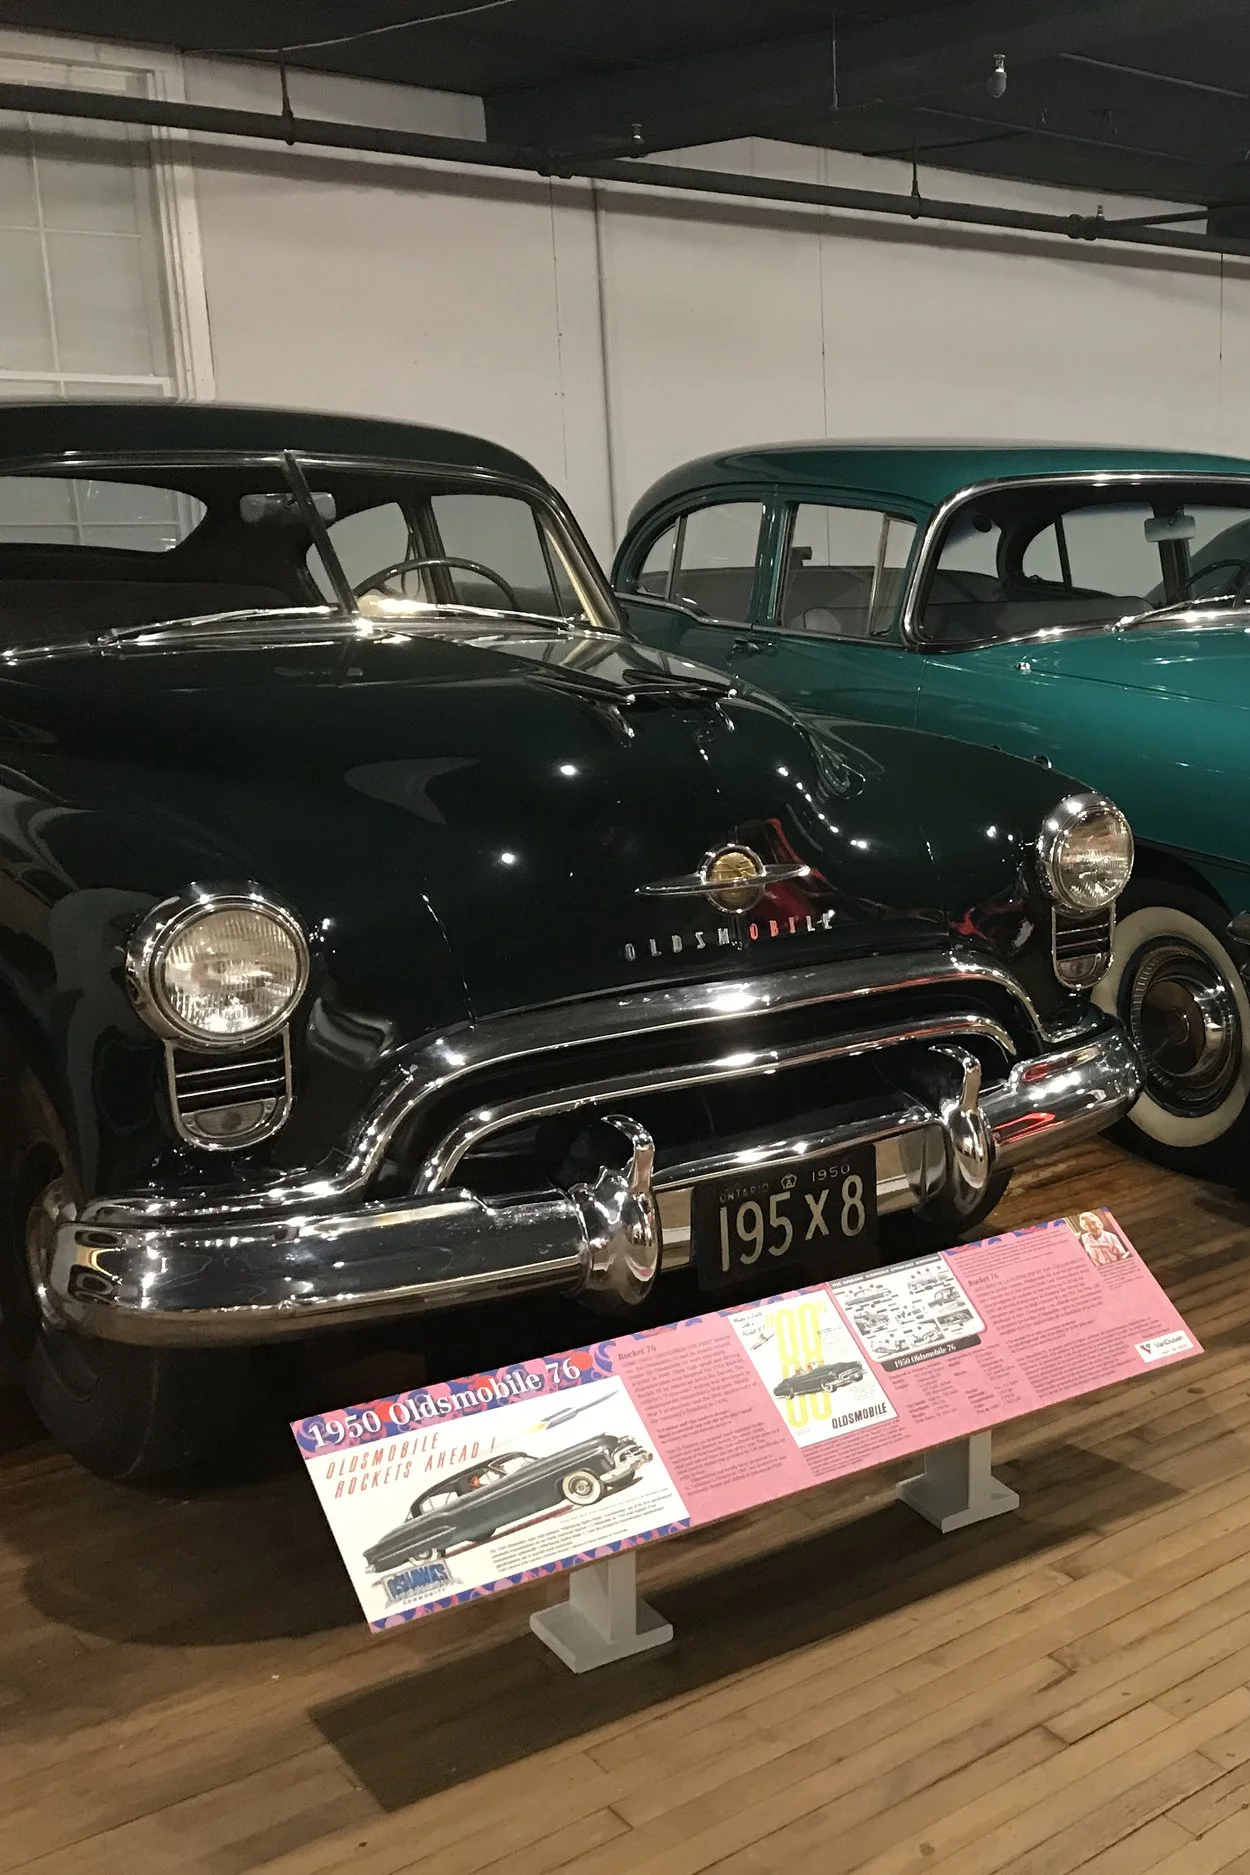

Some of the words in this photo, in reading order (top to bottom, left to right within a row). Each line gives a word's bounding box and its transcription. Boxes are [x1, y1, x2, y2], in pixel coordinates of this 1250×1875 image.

[625, 910, 834, 962] OLDSMOBILE
[812, 1164, 850, 1182] 1950
[968, 1274, 990, 1287] Rocket
[618, 1347, 645, 1361] Rocket
[646, 1345, 657, 1353] 76
[894, 1358, 911, 1368] 1950
[911, 1347, 946, 1362] Oldsmobile
[946, 1343, 957, 1352] 76
[308, 1410, 382, 1448] 1950
[388, 1369, 542, 1426] Oldsmobile
[545, 1357, 581, 1385] 76
[832, 1402, 888, 1430] OLDSMOBILE
[326, 1432, 440, 1480] OLDSMOBILE
[335, 1461, 412, 1499] ROCKETS
